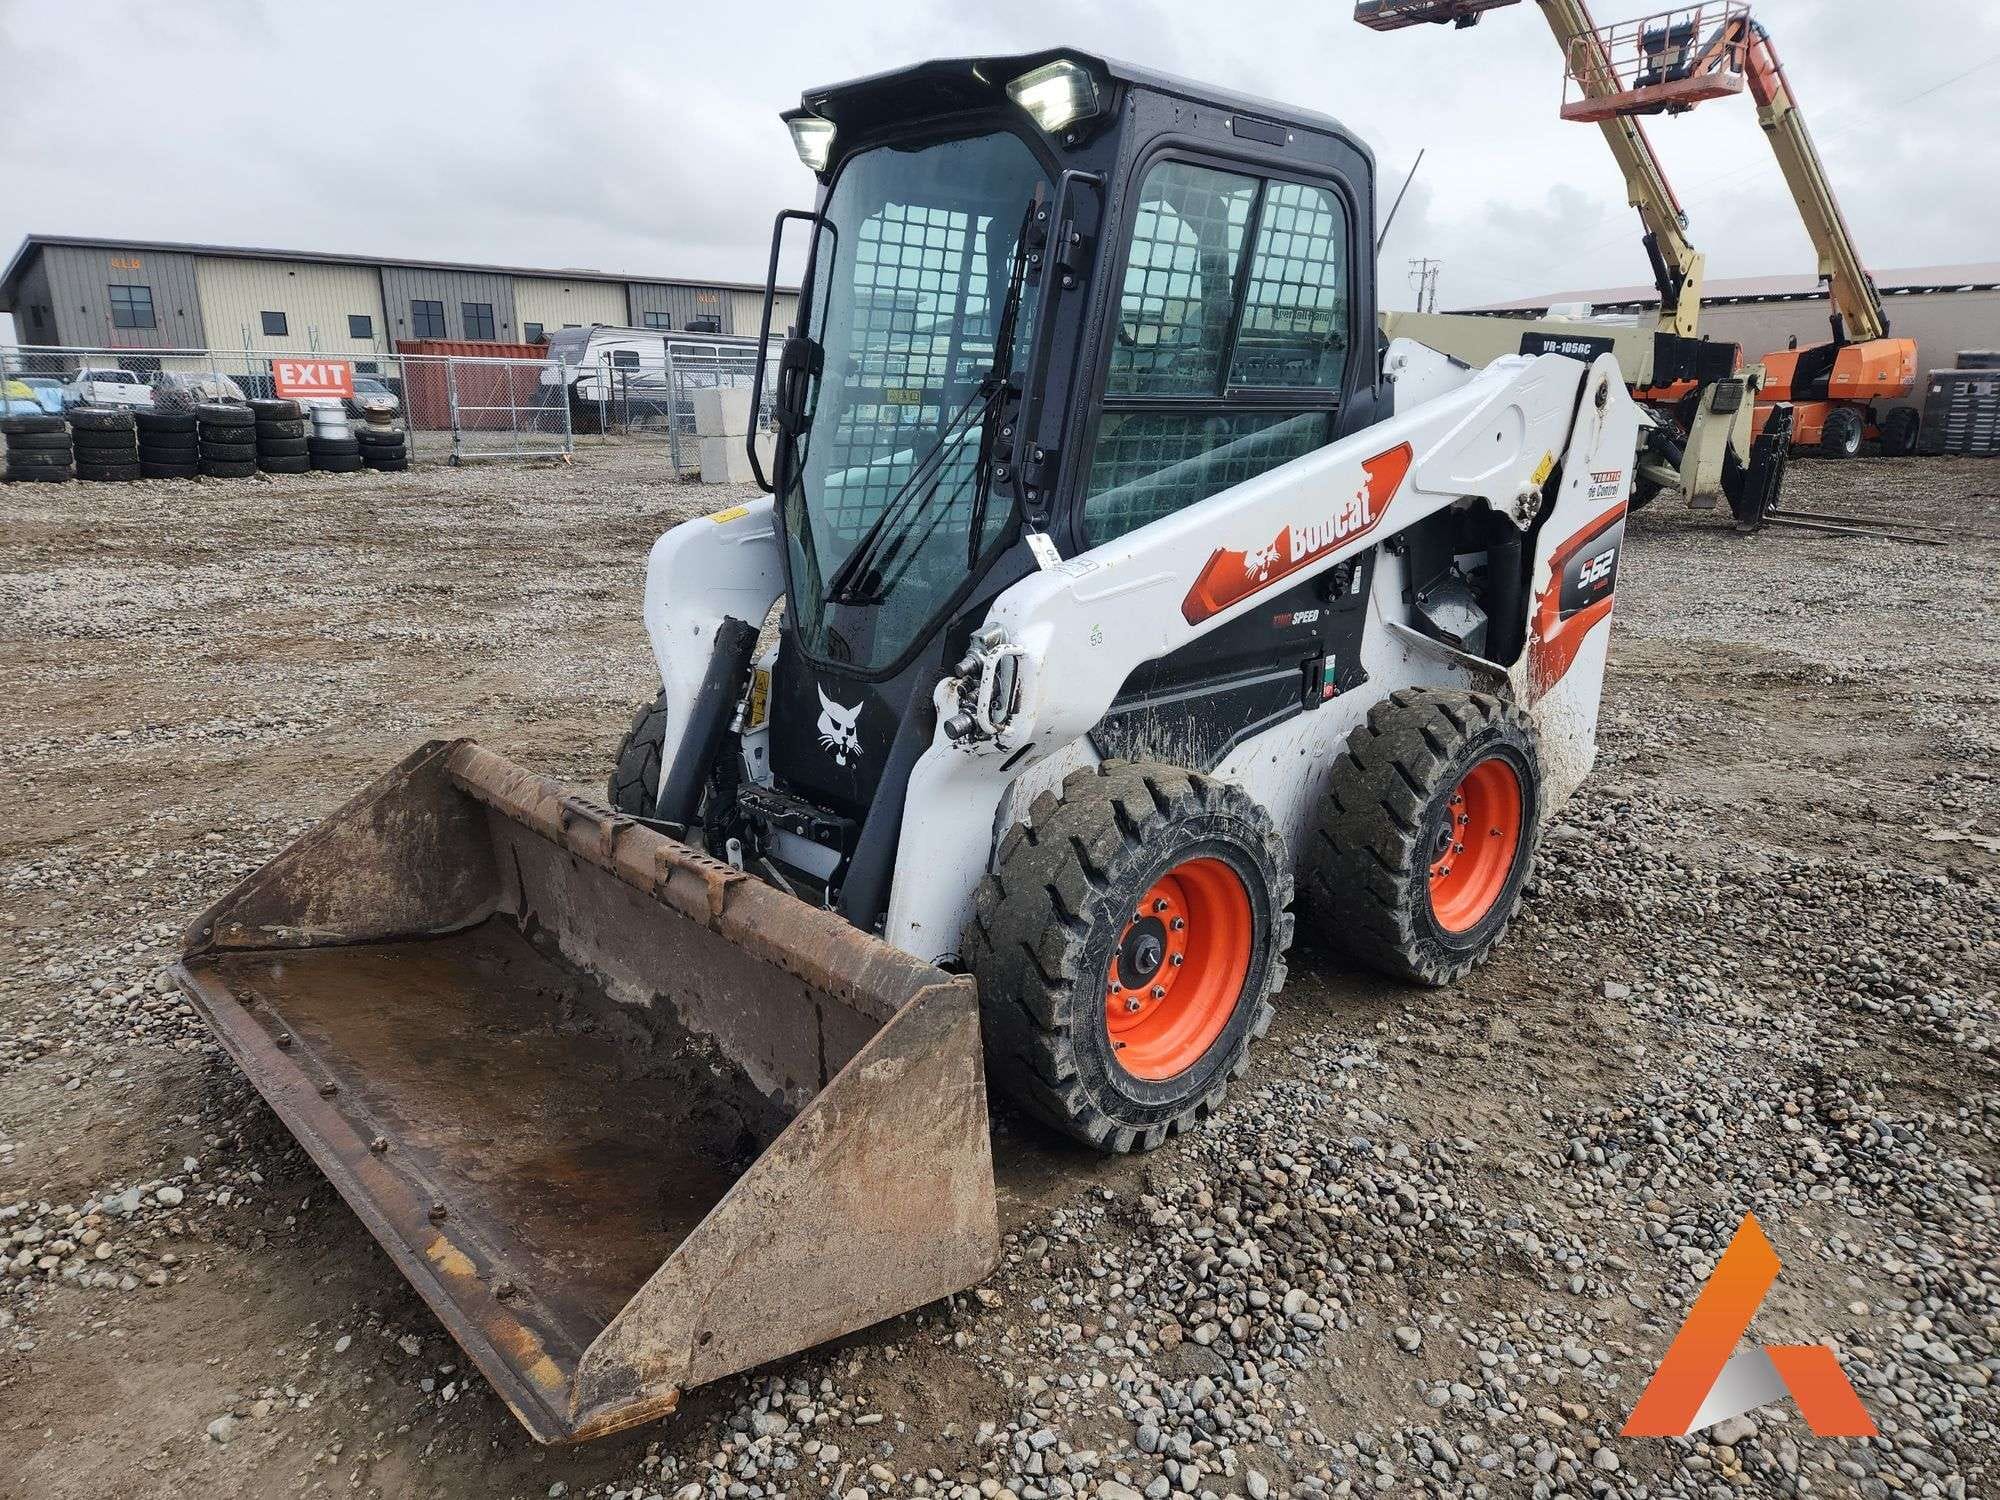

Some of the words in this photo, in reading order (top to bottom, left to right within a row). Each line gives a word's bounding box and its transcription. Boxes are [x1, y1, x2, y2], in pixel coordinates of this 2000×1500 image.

[279, 363, 344, 386] EXIT
[1288, 486, 1371, 562] Bobcat
[1577, 548, 1615, 590] S62
[1292, 609, 1320, 625] SPEED
